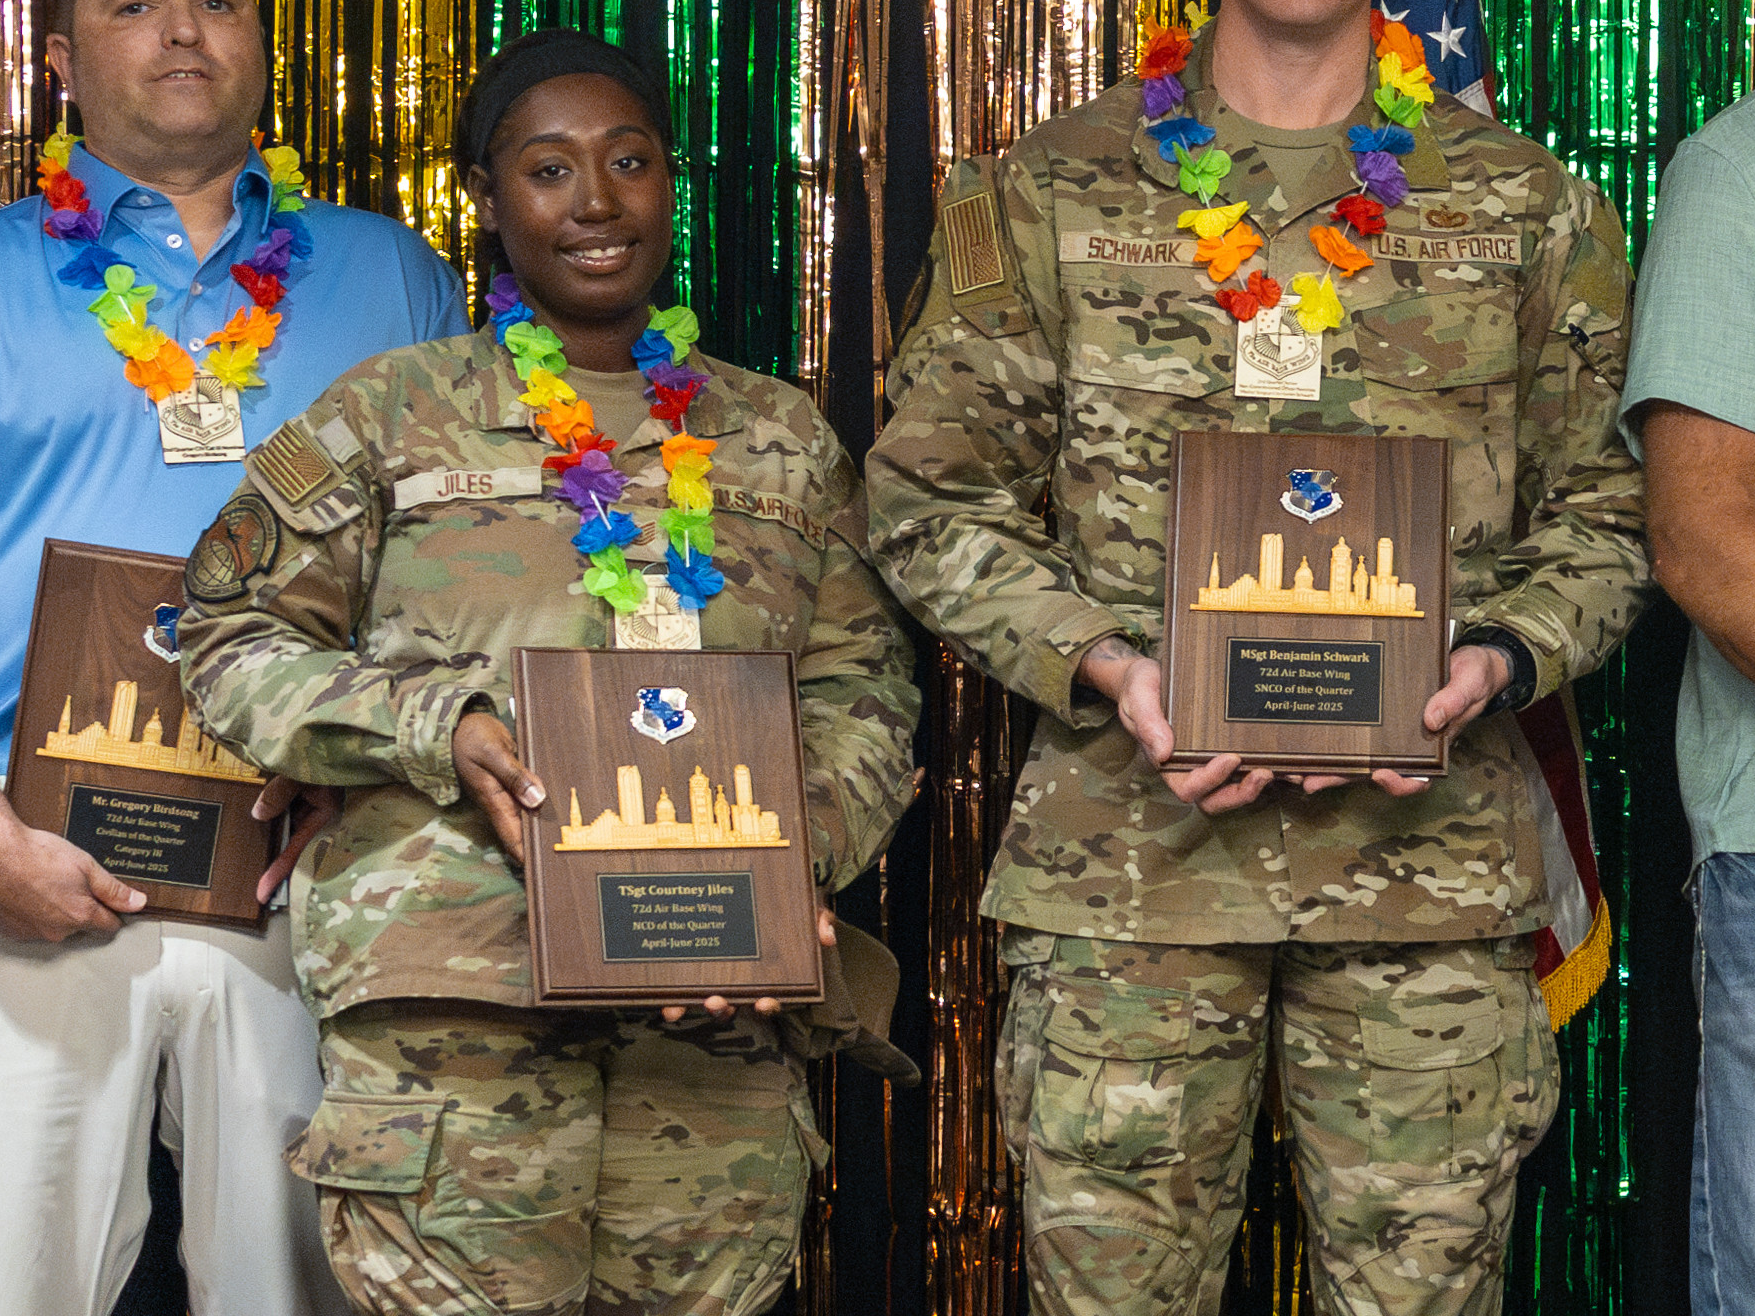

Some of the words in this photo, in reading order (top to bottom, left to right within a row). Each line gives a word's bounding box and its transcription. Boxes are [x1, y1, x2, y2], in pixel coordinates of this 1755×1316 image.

[1087, 236, 1182, 263] SCHWARK
[1378, 235, 1411, 258] U.S.
[1419, 240, 1453, 260] AIR
[1456, 237, 1517, 261] FORCE
[437, 473, 493, 497] JILES
[755, 496, 783, 519] AIR
[1240, 649, 1267, 662] MSgt
[1269, 650, 1322, 662] Benjamin
[1323, 651, 1371, 663] Schwark
[1260, 667, 1279, 677] 72d
[1280, 668, 1297, 677] Air
[1299, 668, 1322, 678] Base
[1324, 669, 1351, 681] Wing
[1254, 684, 1283, 693] SNCO
[1285, 684, 1296, 694] of
[1296, 685, 1314, 694] the
[1315, 685, 1355, 696] Quarter
[1264, 701, 1315, 712] April-June
[1317, 702, 1344, 712] 2025
[92, 795, 109, 807] Mr.
[110, 798, 152, 814] Gregory
[153, 803, 200, 820] Birdsong
[123, 816, 137, 825] Air
[128, 831, 138, 841] of
[153, 835, 186, 846] Quarter
[114, 844, 151, 858] Category
[147, 863, 169, 873] 2025
[618, 885, 647, 899] TSgt
[648, 885, 705, 897] Courtney
[707, 884, 734, 897] Jiles
[631, 904, 652, 913] 72d
[654, 903, 669, 913] Air
[672, 903, 695, 913] Base
[696, 903, 724, 914] Wing
[632, 921, 655, 931] NCO
[657, 921, 668, 931] of
[668, 921, 686, 930] the
[687, 920, 727, 931] Quarter
[641, 937, 693, 950] April-June
[694, 936, 720, 947] 2025
